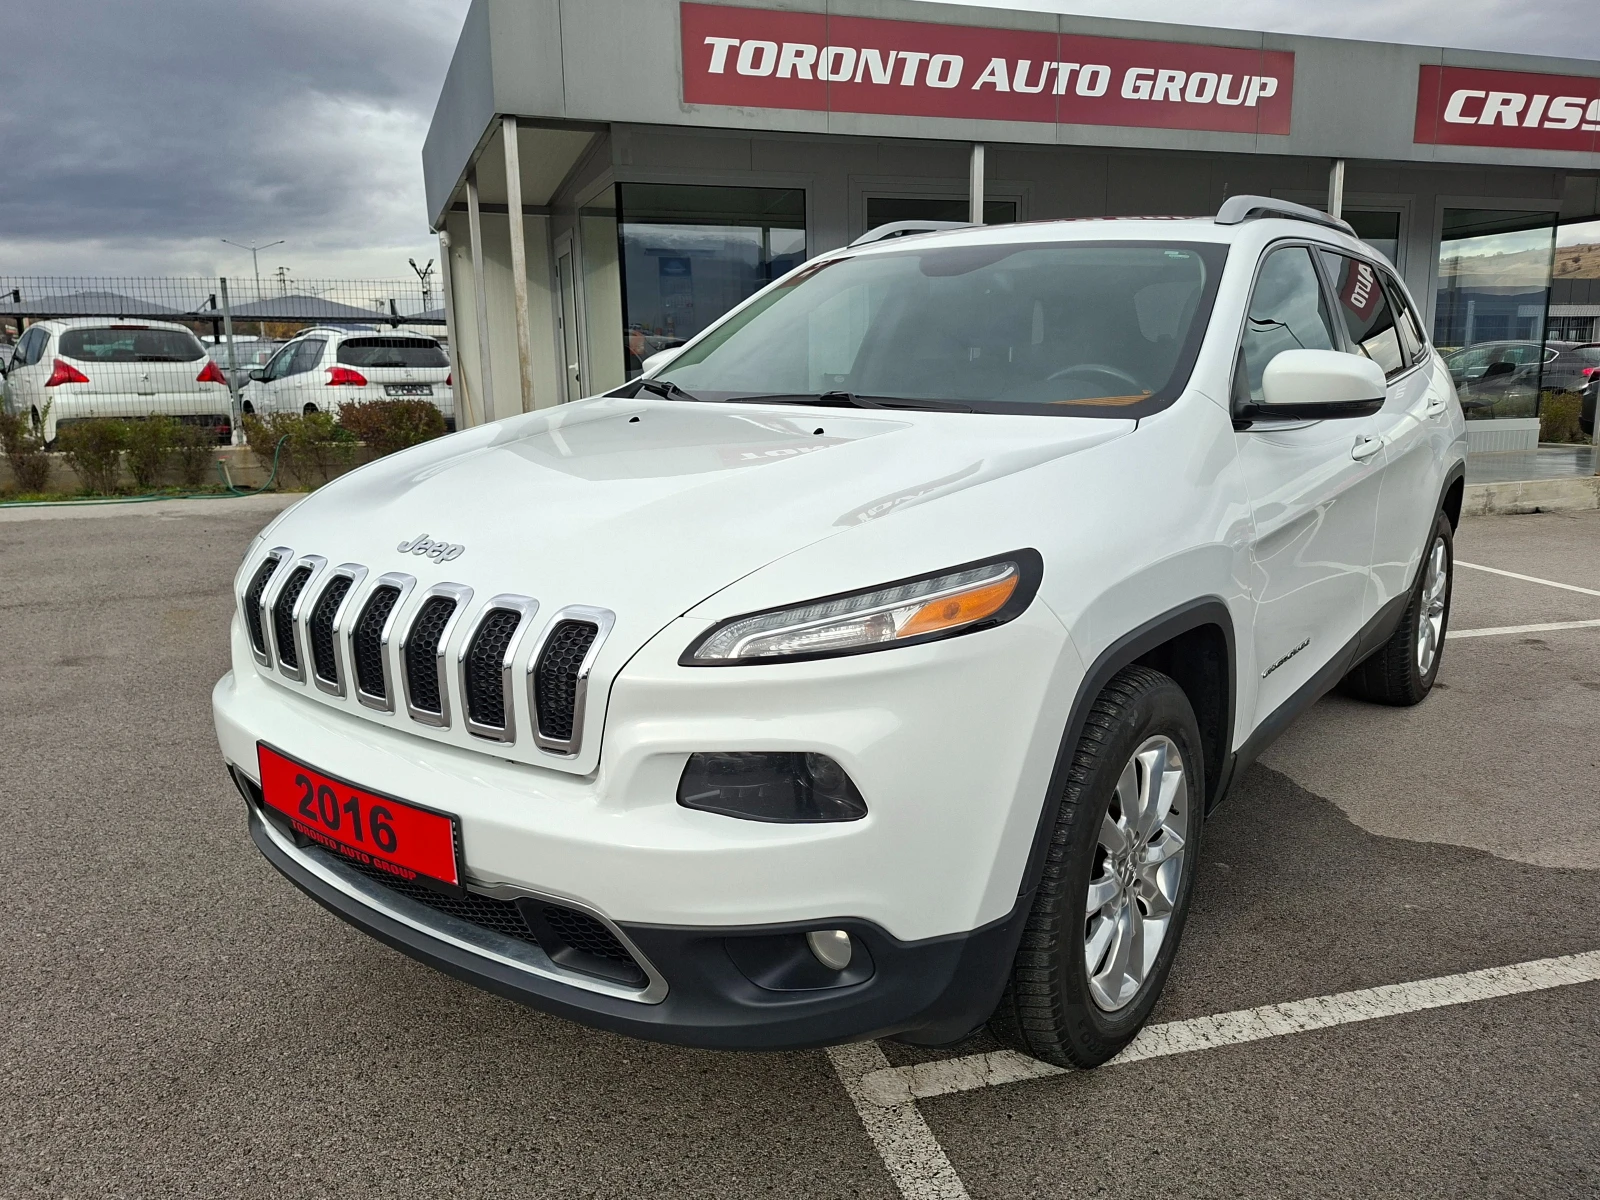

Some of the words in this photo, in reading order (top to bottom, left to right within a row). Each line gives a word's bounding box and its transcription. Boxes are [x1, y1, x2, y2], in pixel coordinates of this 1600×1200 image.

[704, 36, 963, 89] TORONTO
[971, 57, 1111, 97] AUTO
[1120, 67, 1278, 107] GROUP
[397, 533, 465, 564] Jeep
[295, 773, 397, 853] 2016
[291, 819, 337, 851] TORONTO
[340, 844, 370, 864] AUTO
[374, 857, 417, 880] GROUP
